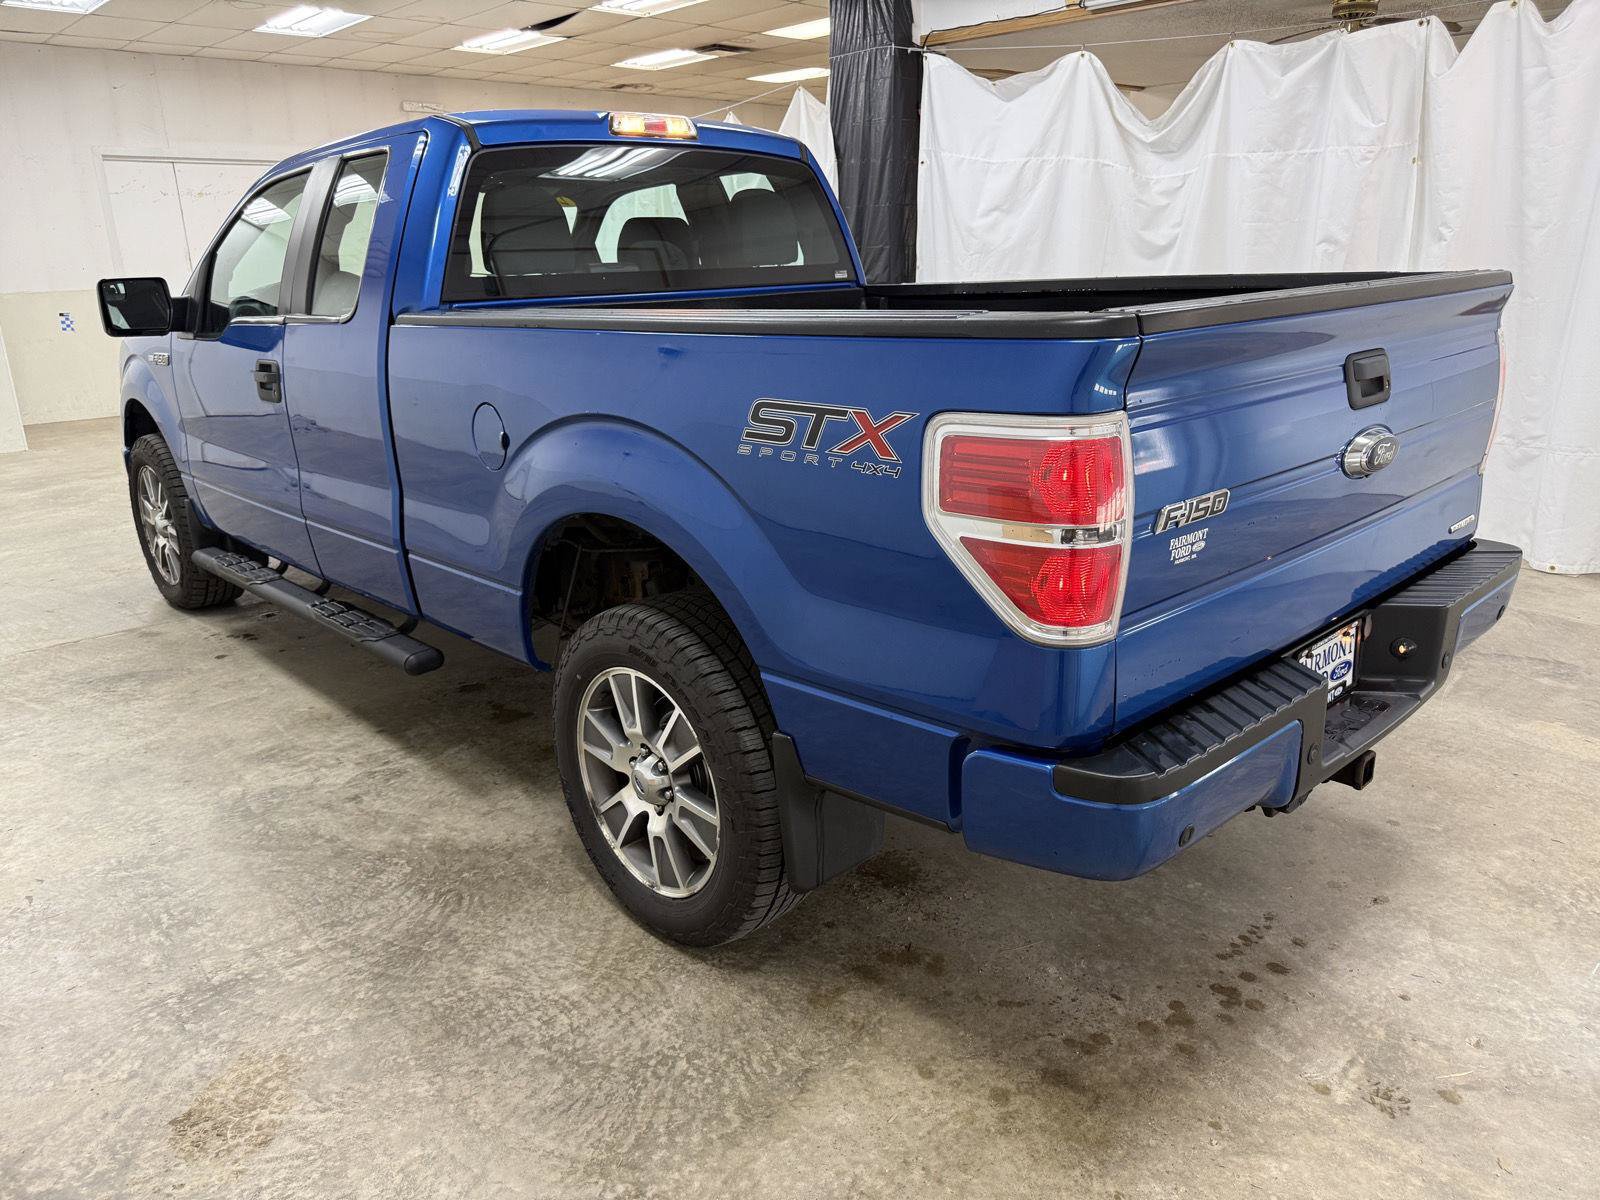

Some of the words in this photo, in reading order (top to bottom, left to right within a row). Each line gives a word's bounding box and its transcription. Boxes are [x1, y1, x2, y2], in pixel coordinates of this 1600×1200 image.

[741, 397, 920, 463] STX
[737, 444, 842, 468] SPORT
[1169, 528, 1208, 550] FAIRMONT
[1170, 544, 1192, 561] FORD
[1332, 661, 1350, 680] Ford
